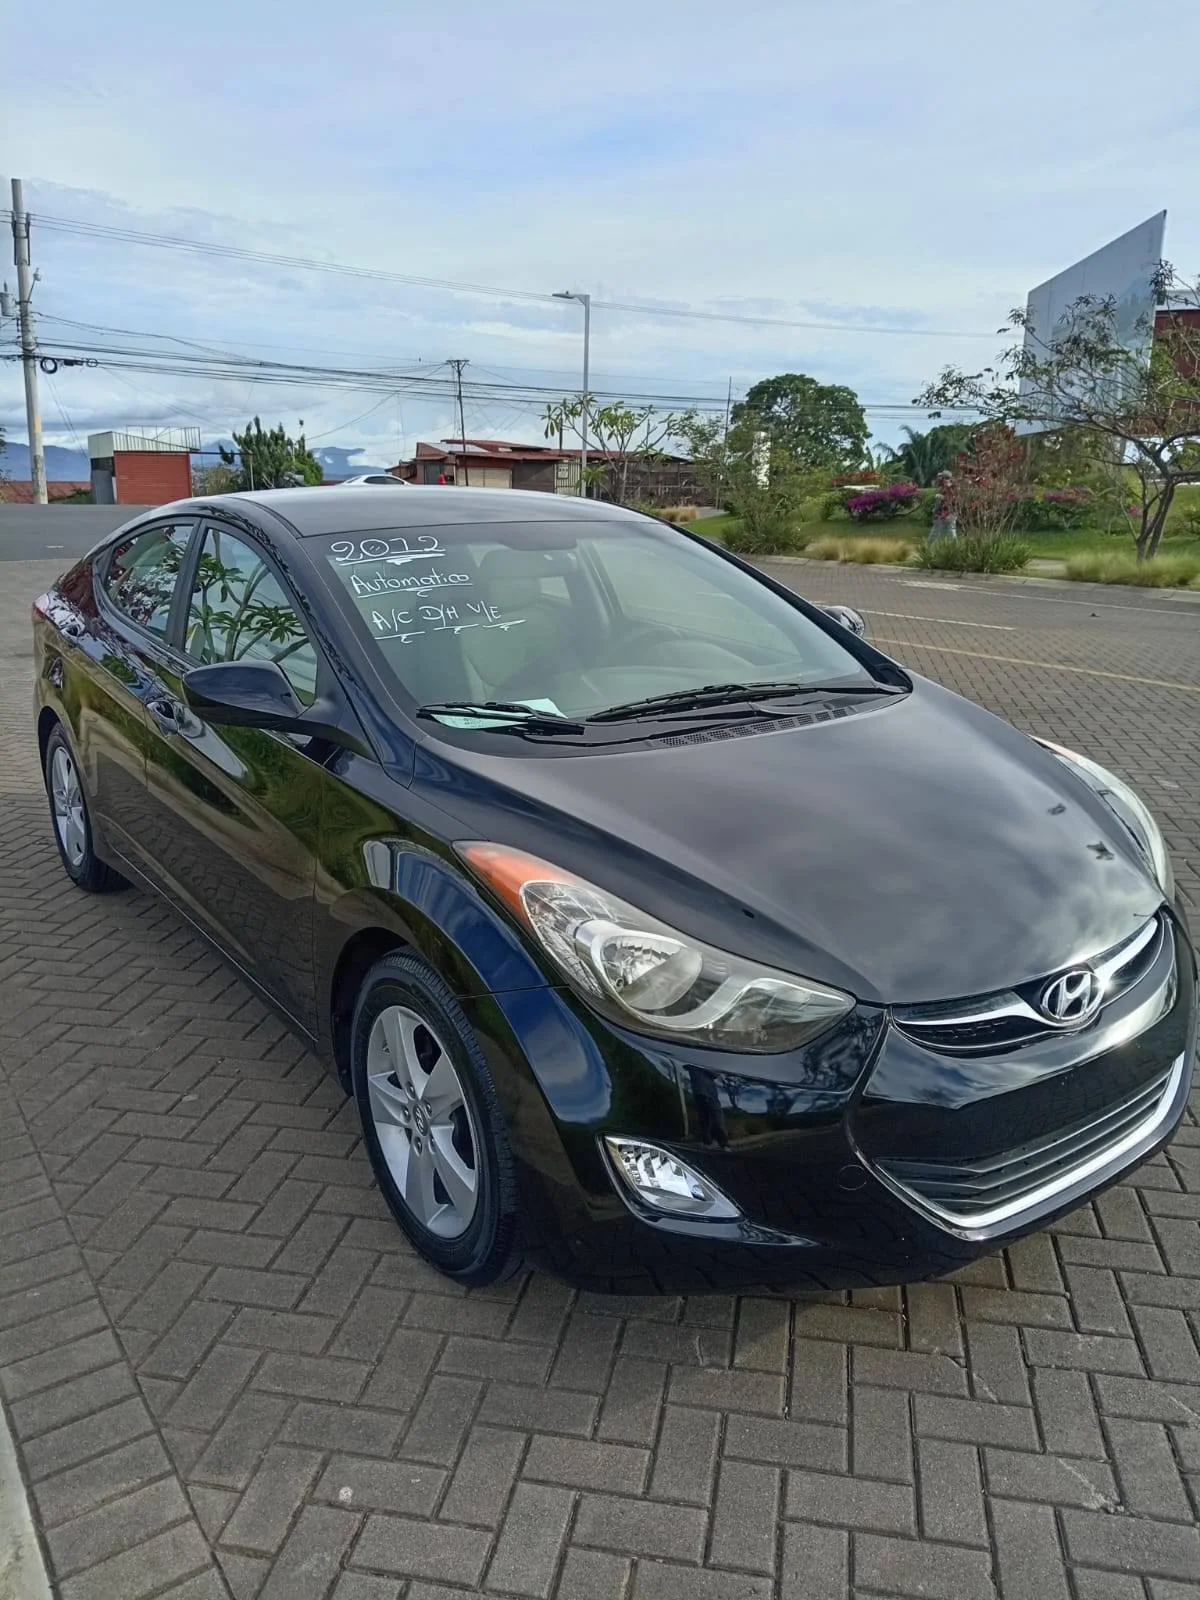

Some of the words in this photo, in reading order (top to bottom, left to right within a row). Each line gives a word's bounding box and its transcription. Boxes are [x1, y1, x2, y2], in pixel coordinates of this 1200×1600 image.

[331, 535, 446, 561] 2012
[371, 608, 413, 632] A/C
[418, 604, 460, 627] D/H
